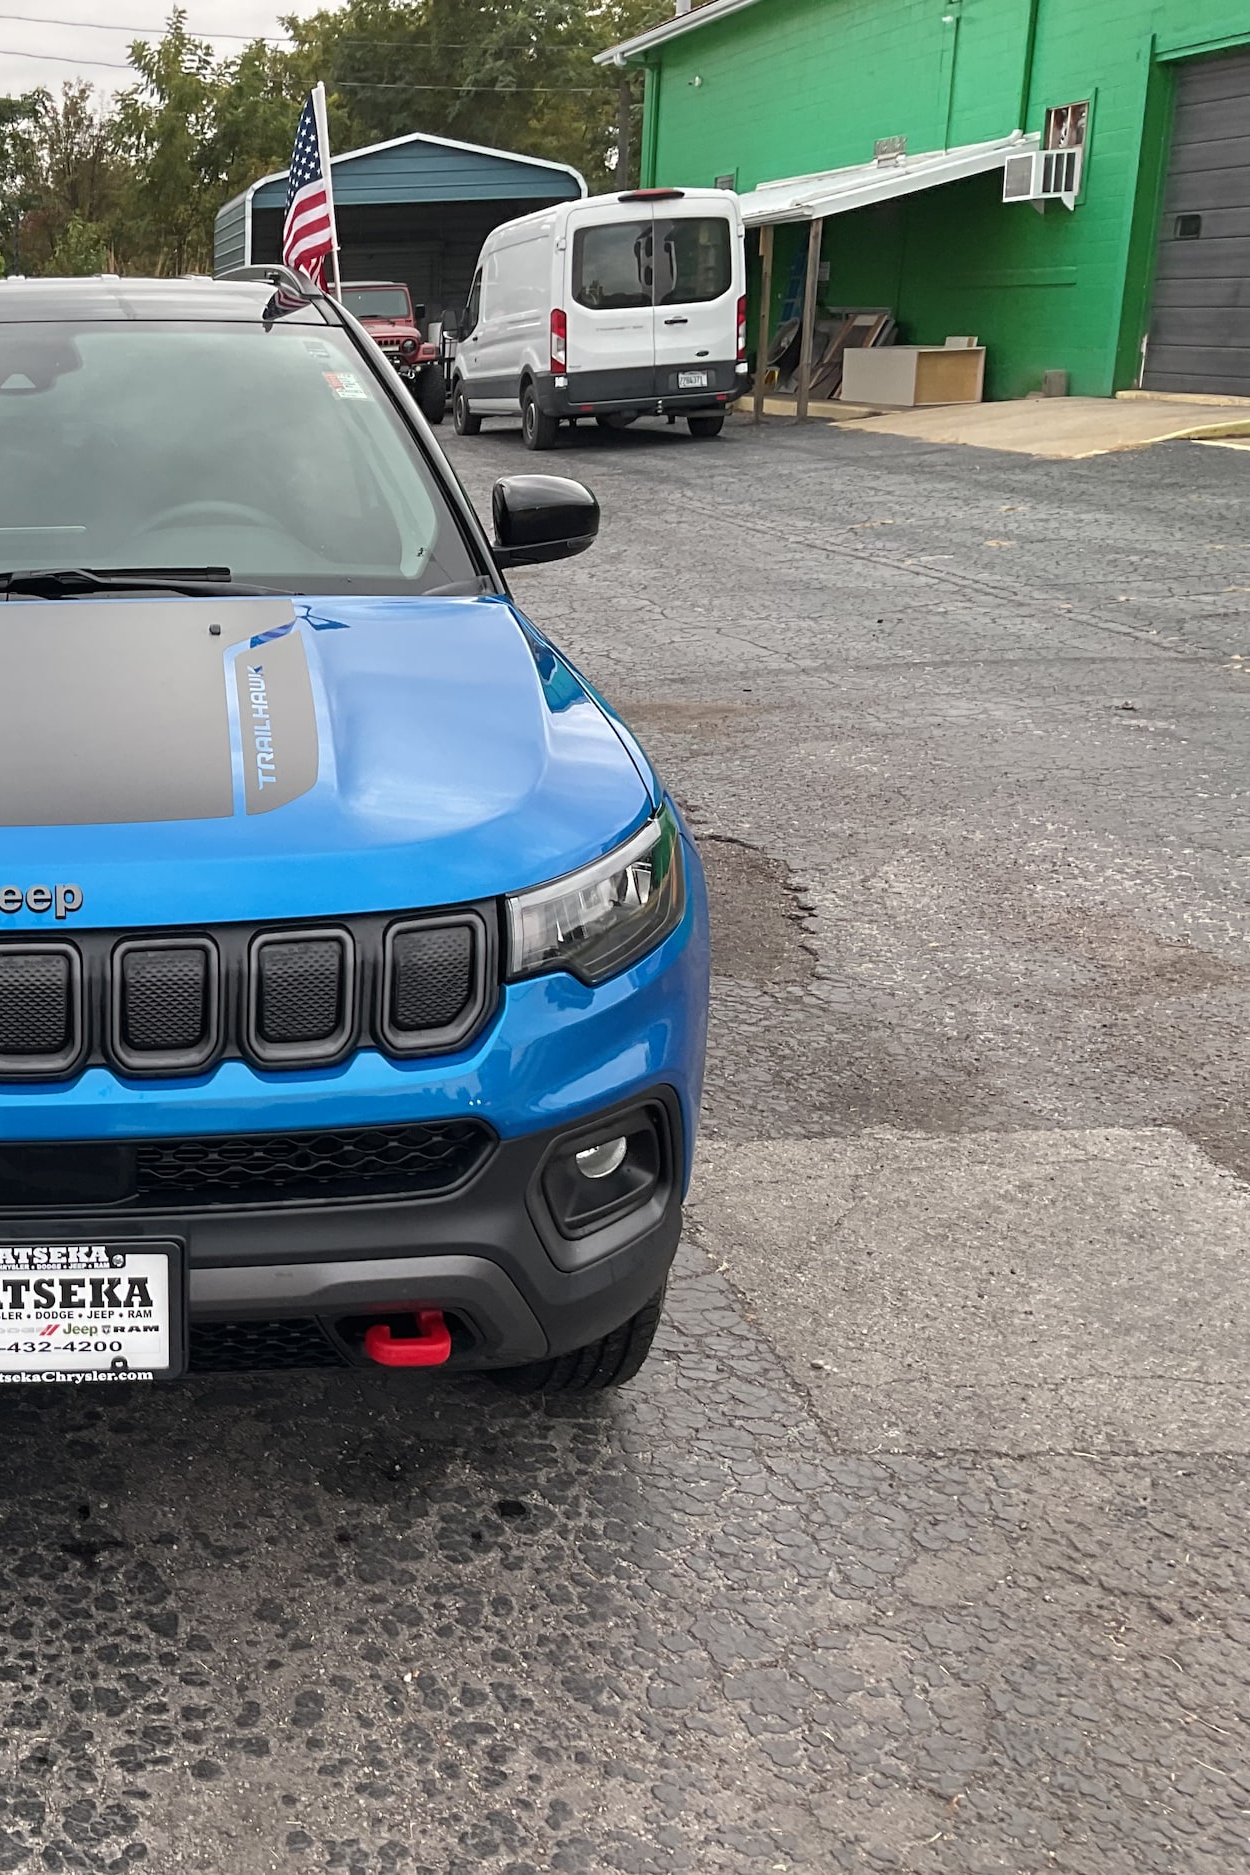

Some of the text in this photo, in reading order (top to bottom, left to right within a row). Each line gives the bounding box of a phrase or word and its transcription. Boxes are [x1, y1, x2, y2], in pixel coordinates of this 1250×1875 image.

[246, 664, 277, 791] TRAILHAWK
[35, 1310, 74, 1320] DODGE
[86, 1310, 115, 1319] JEEP
[127, 1310, 152, 1319] RAM
[62, 1323, 98, 1336] Jeep
[113, 1325, 160, 1333] RAM
